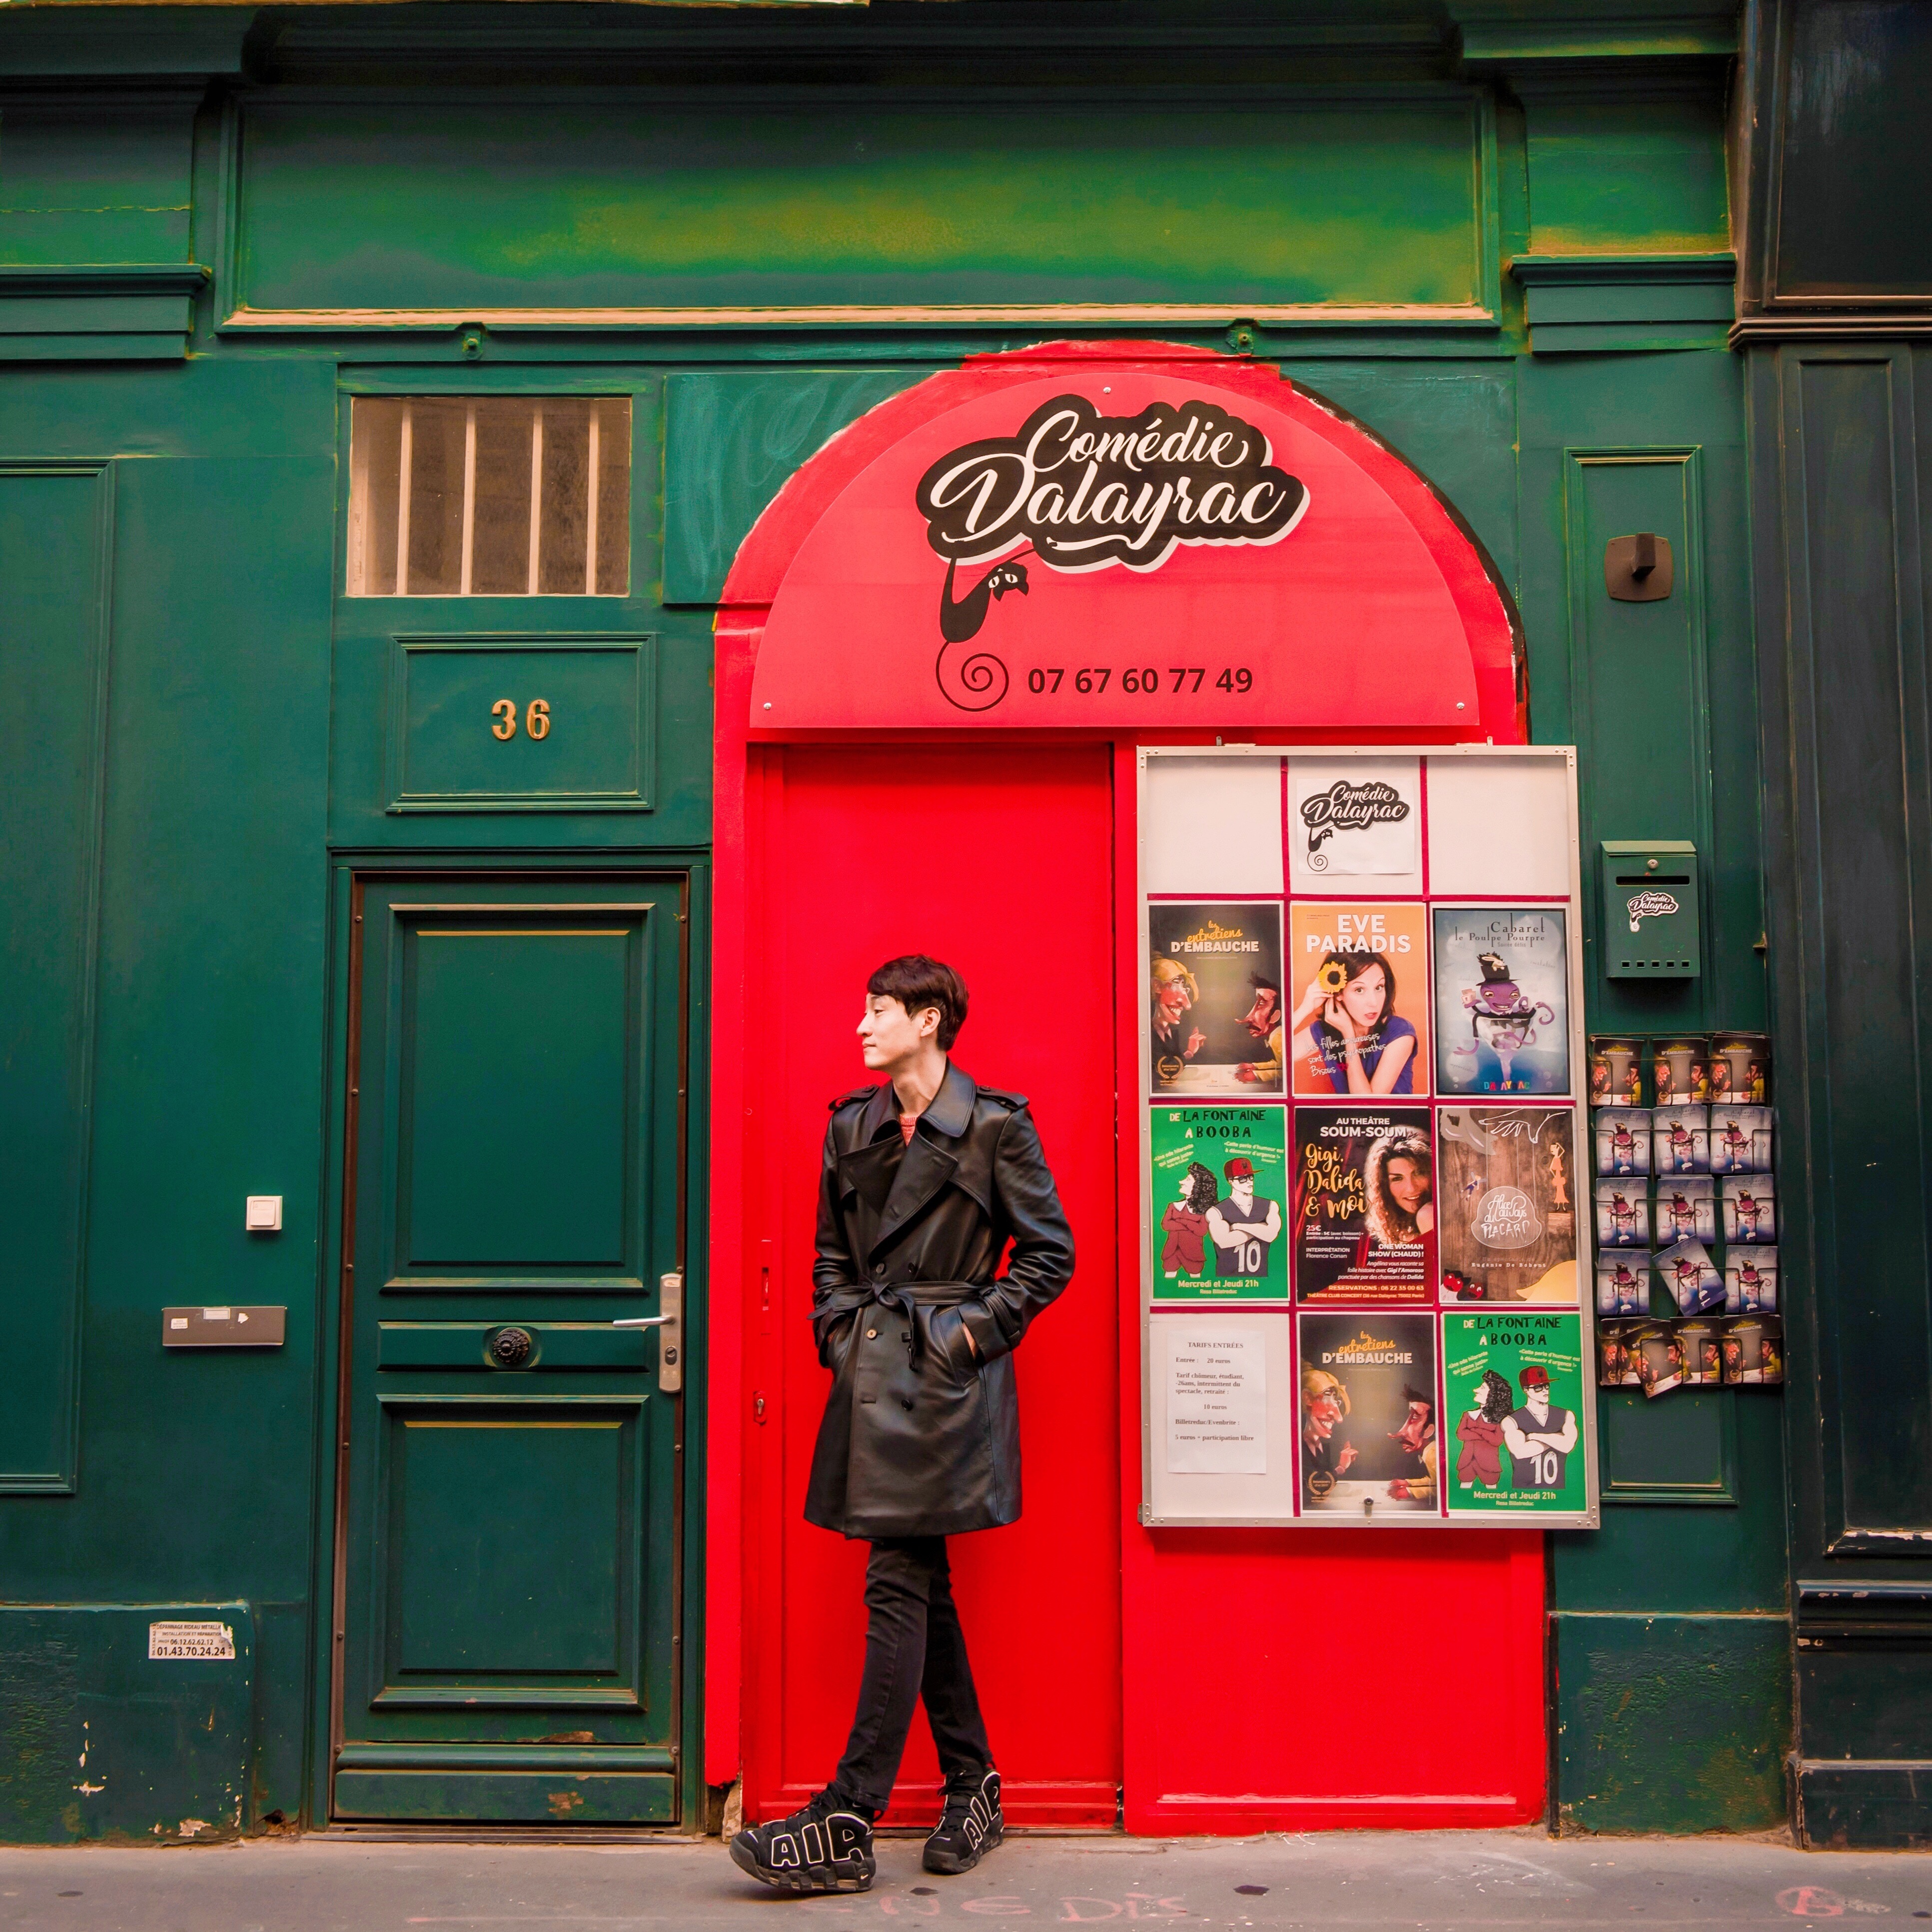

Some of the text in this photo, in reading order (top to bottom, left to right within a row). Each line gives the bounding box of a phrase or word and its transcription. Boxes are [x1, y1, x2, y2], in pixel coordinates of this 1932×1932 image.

[1025, 410, 1249, 472] Comédie
[931, 453, 1287, 551] Dalayrac
[1028, 668, 1252, 694] 07 67 60 77 49
[492, 699, 550, 739] 36
[1331, 785, 1394, 803] Comédie
[1304, 797, 1405, 826] Dalayrac
[1629, 899, 1674, 913] Dalayrac
[1641, 894, 1670, 903] Comédie
[1338, 914, 1386, 933] EVE
[1491, 913, 1545, 933] Cabaret
[1187, 926, 1243, 943] entretiens
[1306, 934, 1411, 953] PARADIS
[1455, 926, 1545, 947] le Poulpe Pourpre
[1321, 1036, 1339, 1050] filles
[1341, 1033, 1380, 1045] amoureuses
[1308, 1041, 1387, 1064] sont des psychopathes
[1309, 1065, 1336, 1077] Bisous
[1169, 1113, 1180, 1121] DE
[1183, 1110, 1199, 1122] LA
[1196, 1126, 1251, 1138] BOOBA
[1320, 1126, 1406, 1137] SOUM-SOUM
[1305, 1143, 1344, 1172] Gigi,
[1303, 1165, 1366, 1194] Dalida
[1305, 1192, 1370, 1220] & moi
[1484, 1210, 1494, 1223] du
[1233, 1241, 1261, 1273] 10
[1463, 1319, 1475, 1328] DE
[1477, 1317, 1494, 1329] LA
[1360, 1330, 1371, 1339] les
[1491, 1333, 1547, 1345] BOOBA
[1339, 1338, 1396, 1353] entretiens
[1530, 1451, 1558, 1484] 10
[157, 1646, 225, 1656] 01.43.70.24.24
[771, 1812, 873, 1867] AIR
